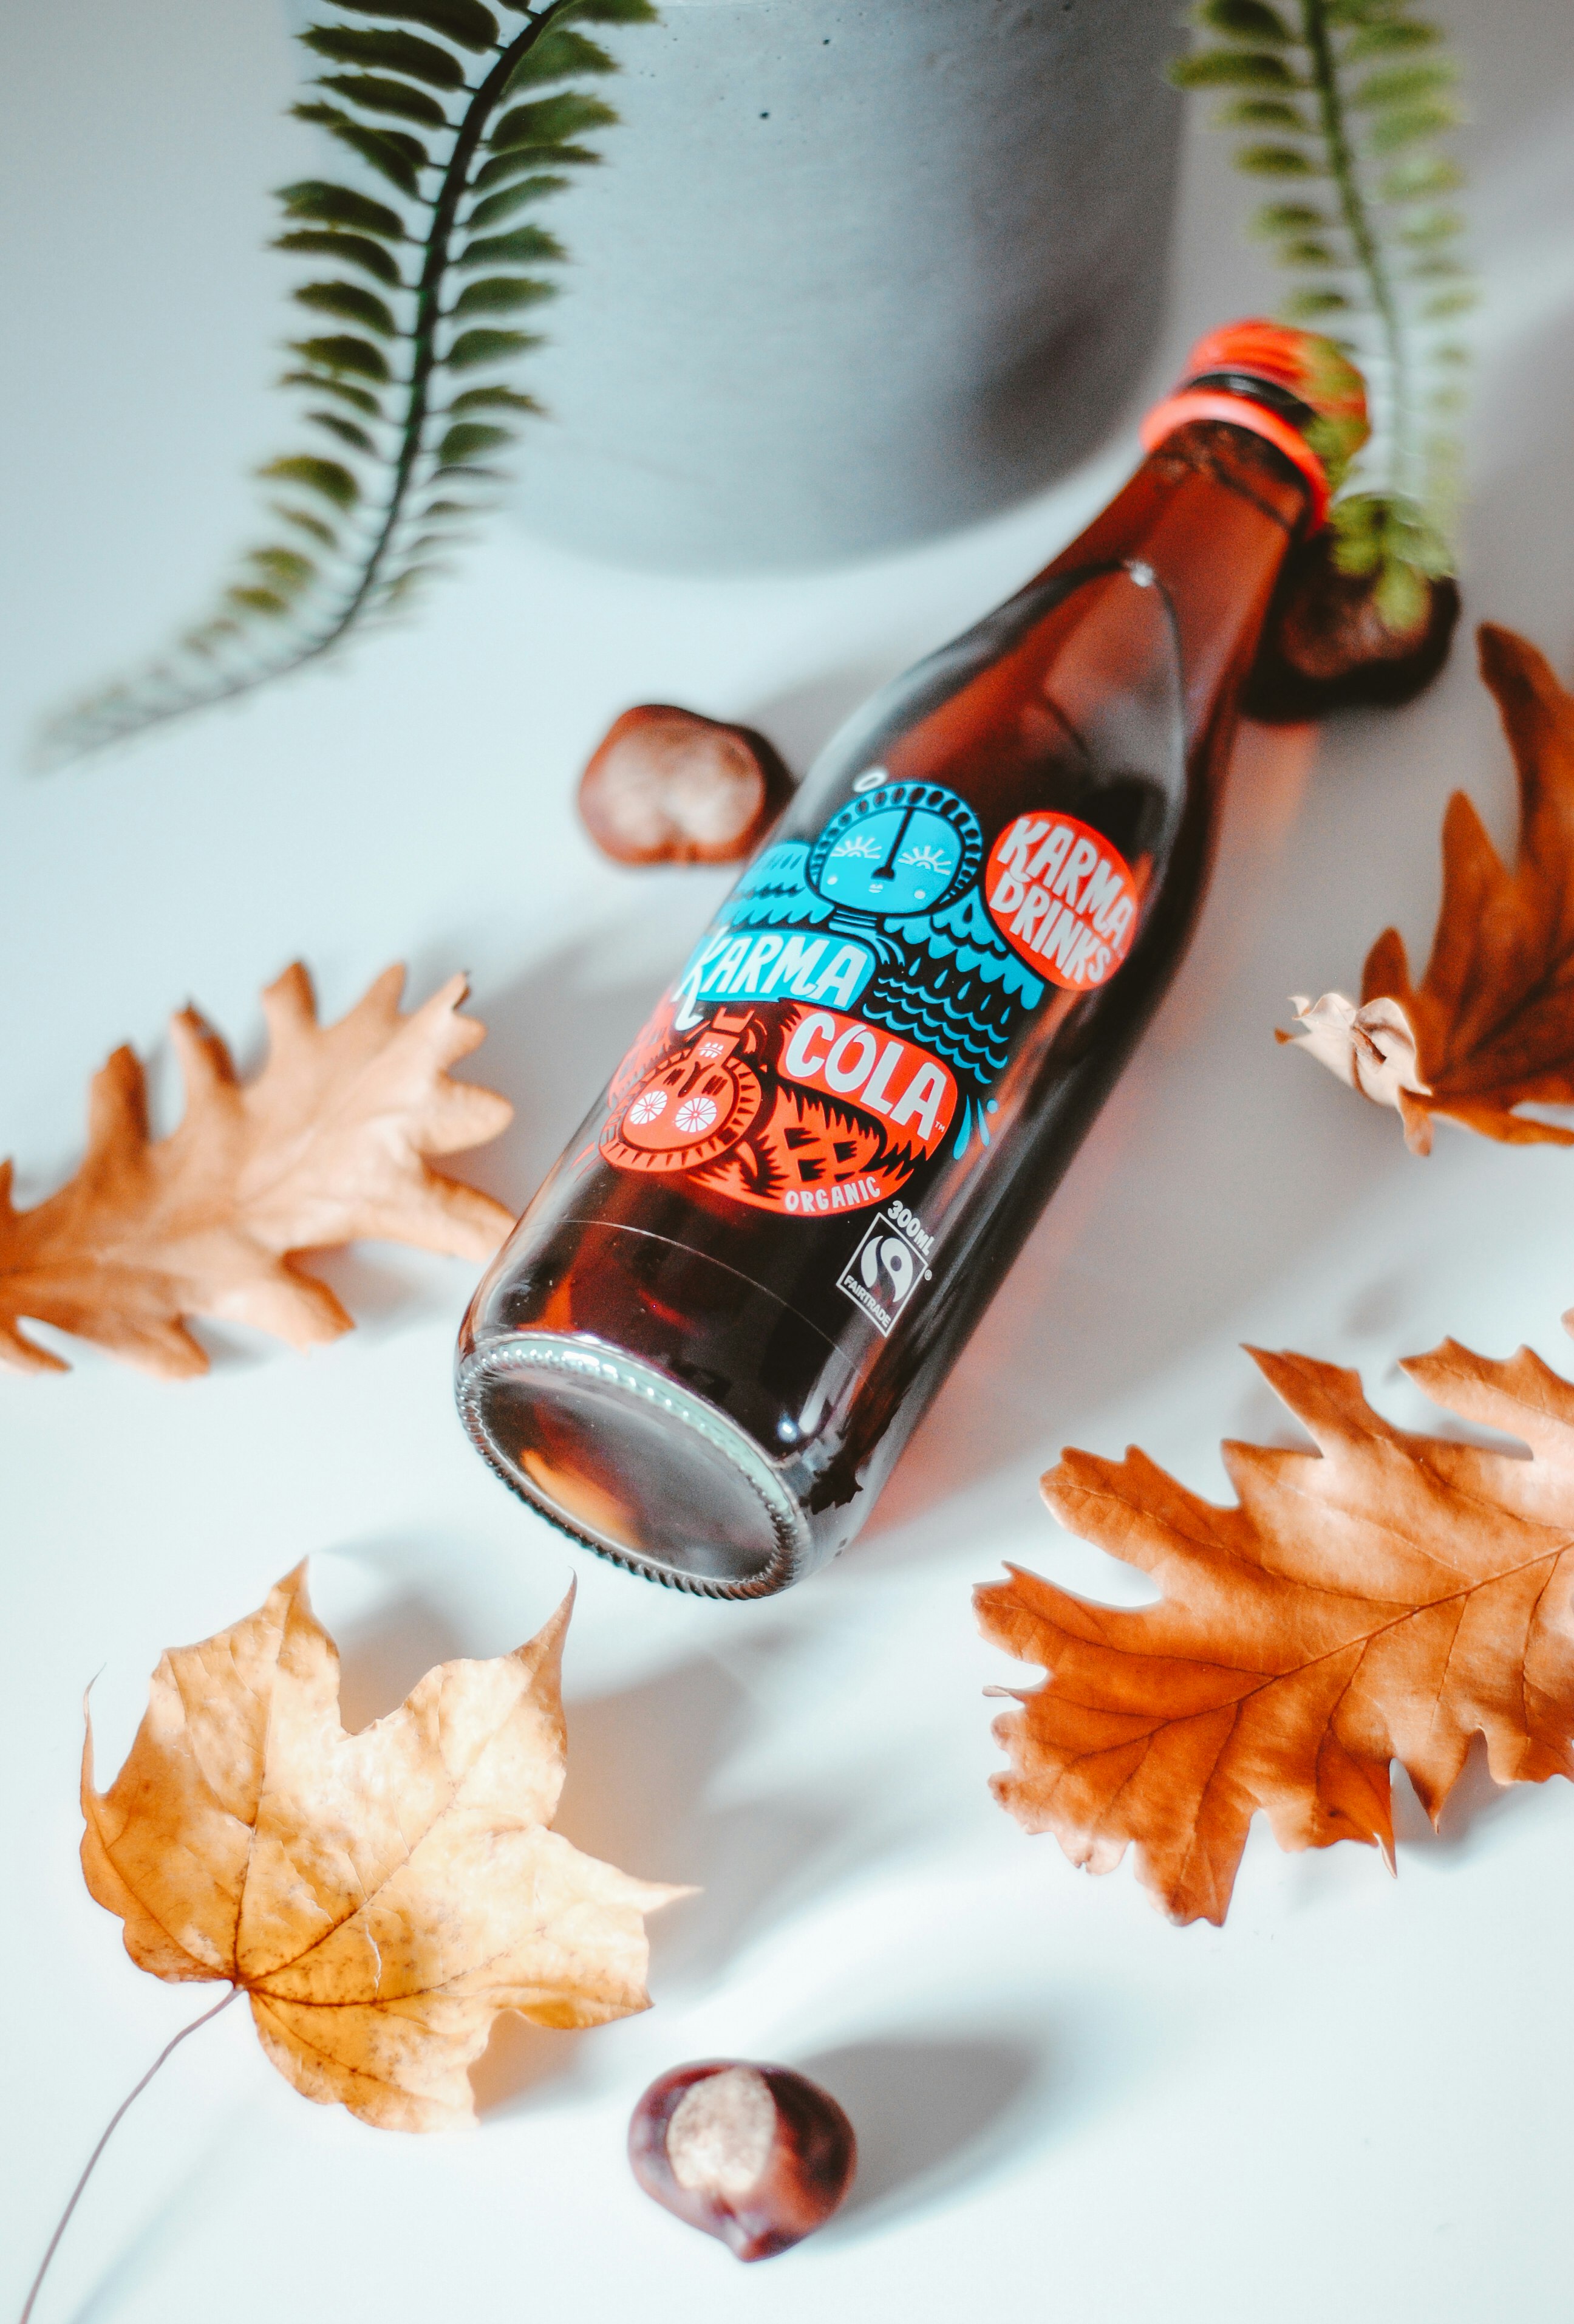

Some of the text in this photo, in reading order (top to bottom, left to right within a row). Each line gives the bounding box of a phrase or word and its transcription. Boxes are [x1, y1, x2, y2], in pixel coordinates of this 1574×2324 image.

[989, 871, 1111, 983] DRINKS
[997, 818, 1133, 949] KARMA
[670, 926, 868, 1031] KARMA
[786, 1012, 947, 1140] COLA
[785, 1176, 881, 1212] ORGANIC
[843, 1275, 891, 1328] FAIRTRADE
